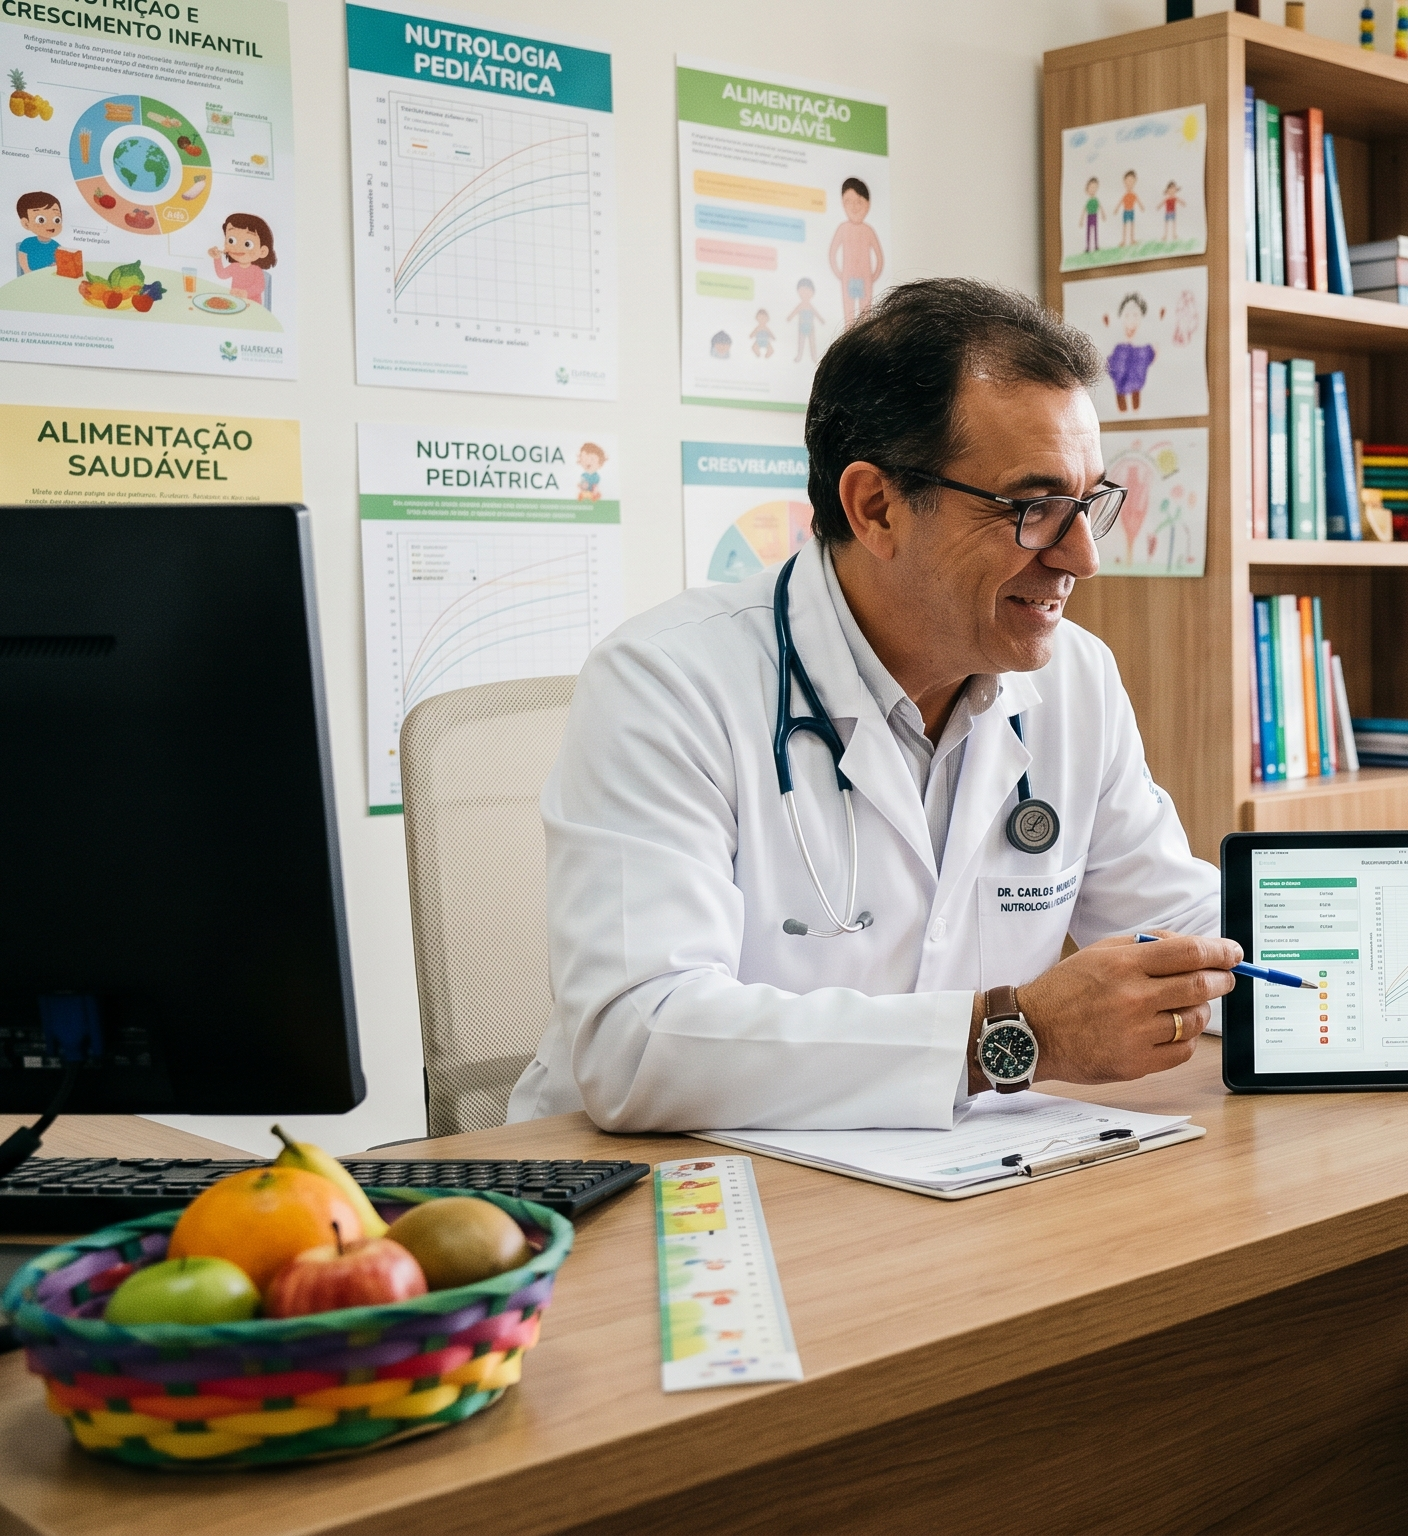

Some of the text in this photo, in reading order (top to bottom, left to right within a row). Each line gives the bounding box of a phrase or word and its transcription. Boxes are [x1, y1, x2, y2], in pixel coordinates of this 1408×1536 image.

[2, 0, 263, 59] CRESCIMENTO INFANTIL
[187, 7, 199, 24] E
[404, 22, 563, 72] NUTROLOGIA
[414, 52, 556, 97] PEDIÁTRICA
[722, 82, 851, 125] ALIMENTAÇÃO
[739, 107, 837, 143] SAUDÁVEL
[37, 420, 253, 455] ALIMENTAÇÃO
[416, 440, 566, 465] NUTROLOGIA
[68, 451, 228, 481] SAUDÁVEL
[426, 465, 559, 490] PEDIÁTRICA
[997, 887, 1014, 898] DR.
